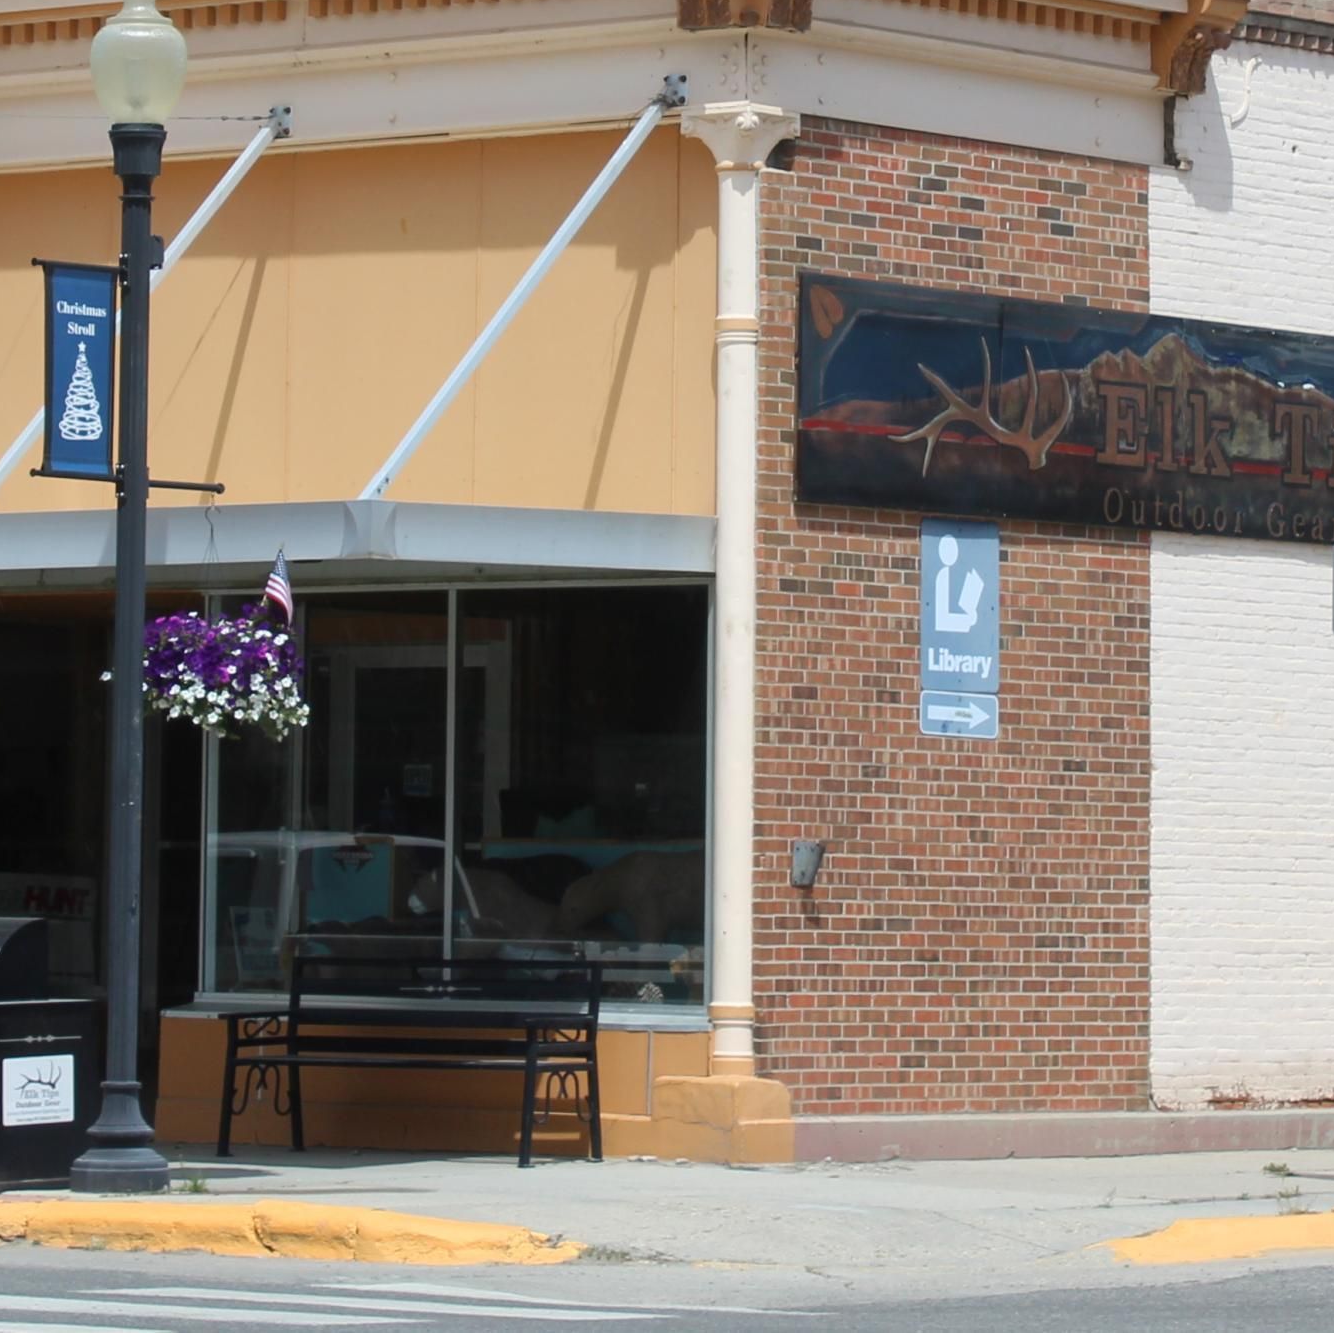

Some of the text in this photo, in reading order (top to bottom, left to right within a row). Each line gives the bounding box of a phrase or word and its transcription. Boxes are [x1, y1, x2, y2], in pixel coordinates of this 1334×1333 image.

[56, 300, 107, 318] Christmas
[67, 321, 95, 337] Stroll
[1097, 380, 1231, 478] Elk
[1103, 487, 1245, 535] Outdoor
[927, 647, 992, 679] Library
[24, 1089, 40, 1099] Elk
